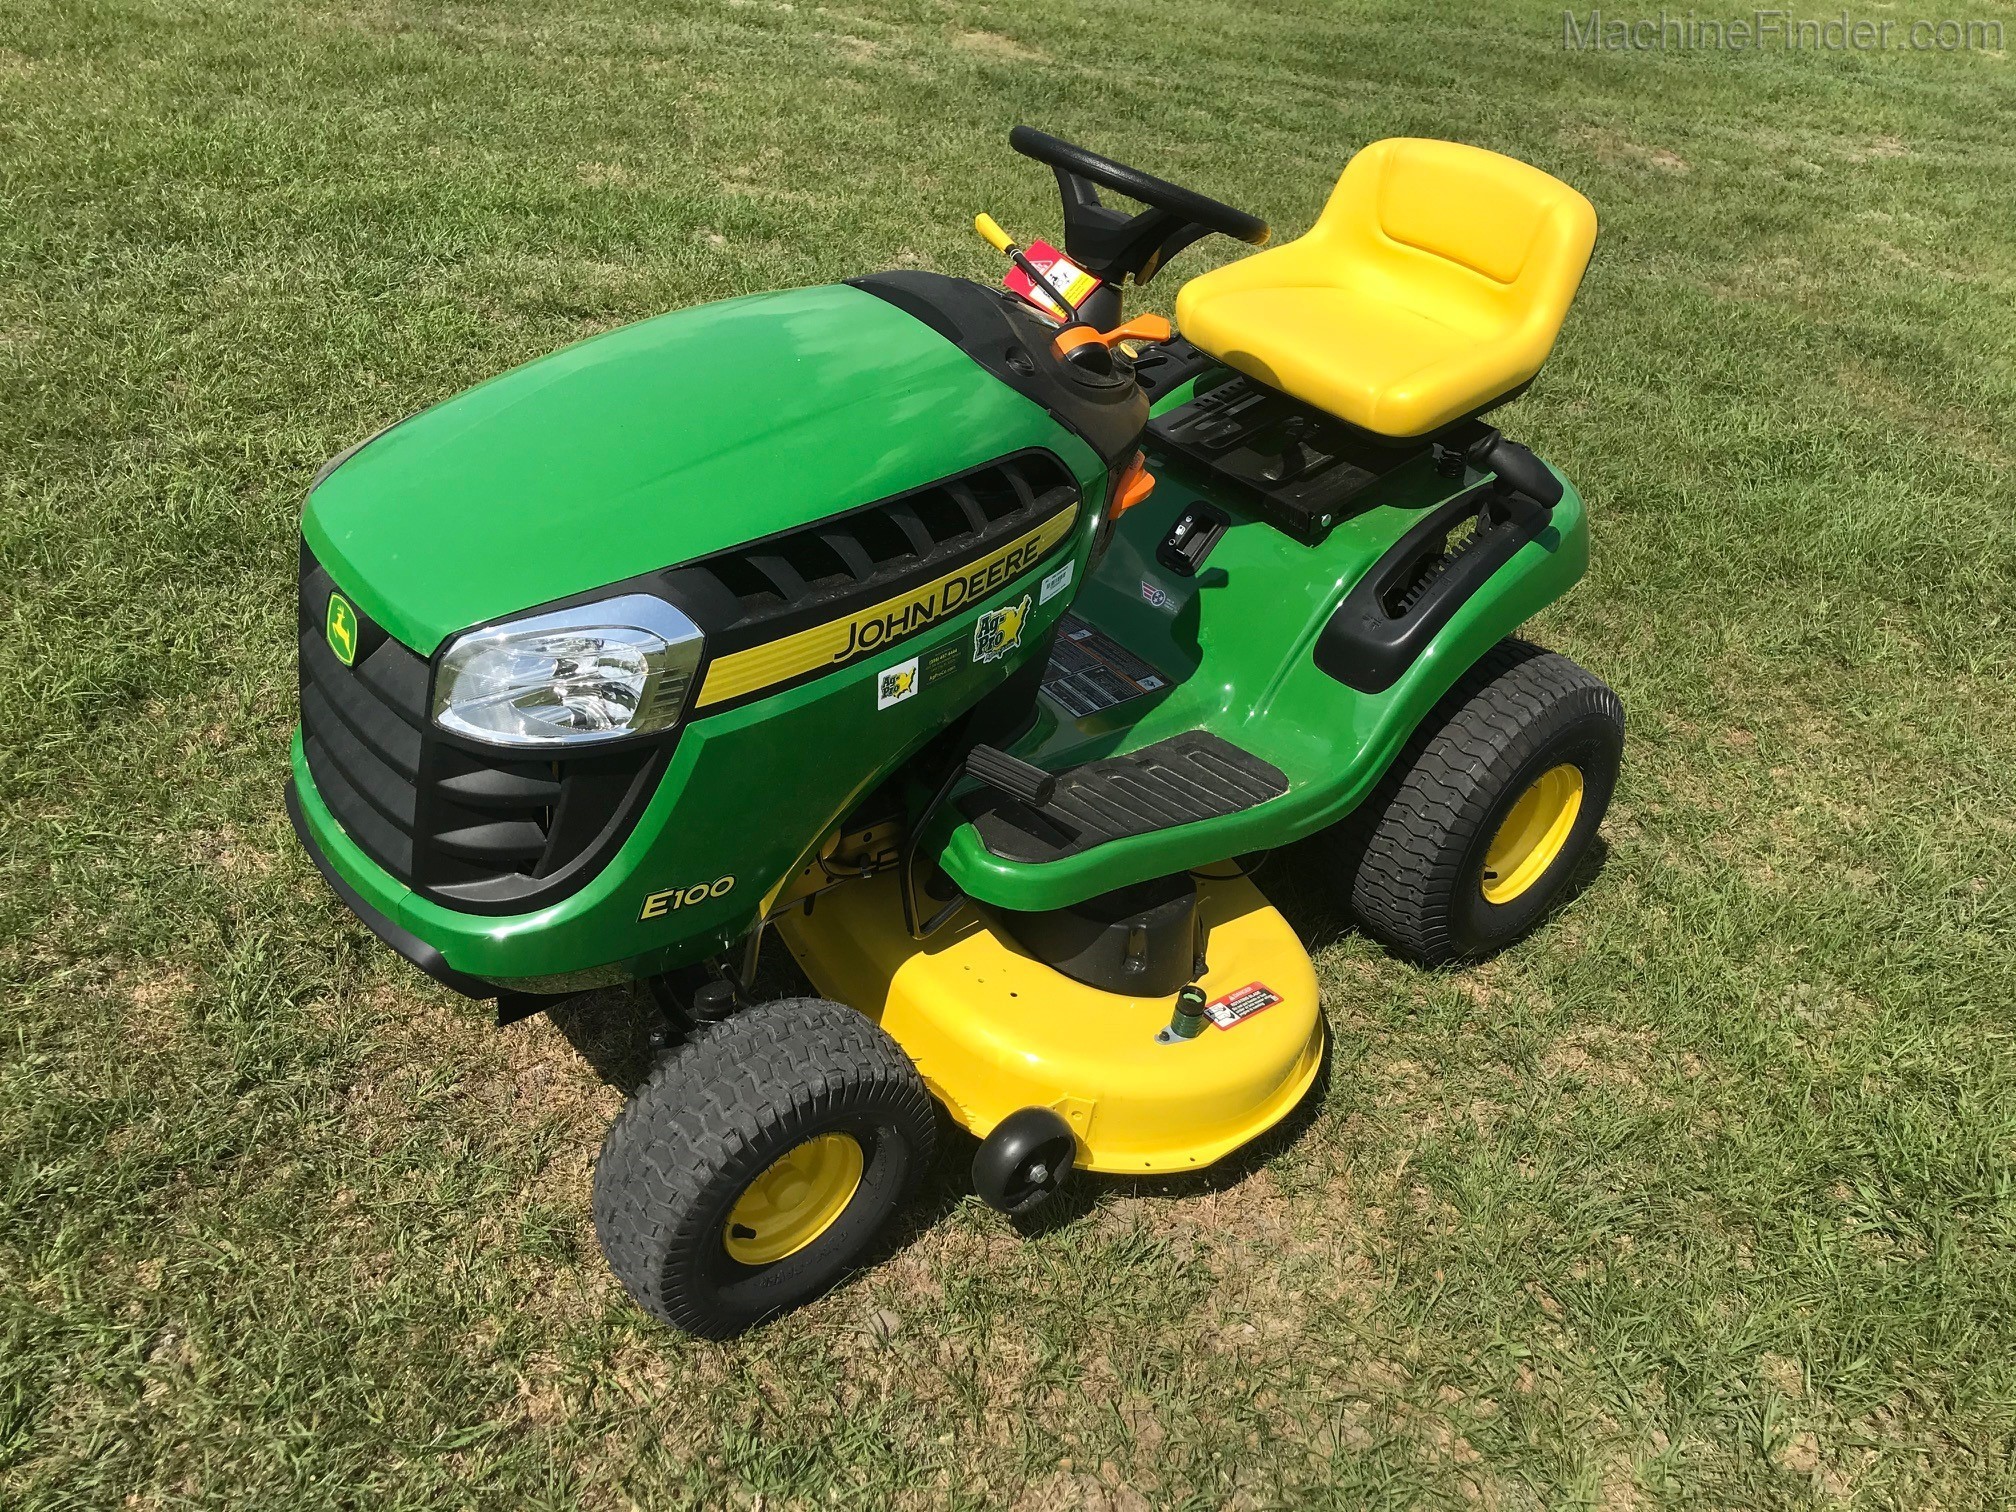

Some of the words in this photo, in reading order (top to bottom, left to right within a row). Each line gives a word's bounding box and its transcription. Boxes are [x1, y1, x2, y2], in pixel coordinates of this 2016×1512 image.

[833, 594, 935, 662] JOHN
[941, 534, 1041, 612] DEERE
[975, 630, 1004, 659] Pro
[640, 875, 735, 920] E100
